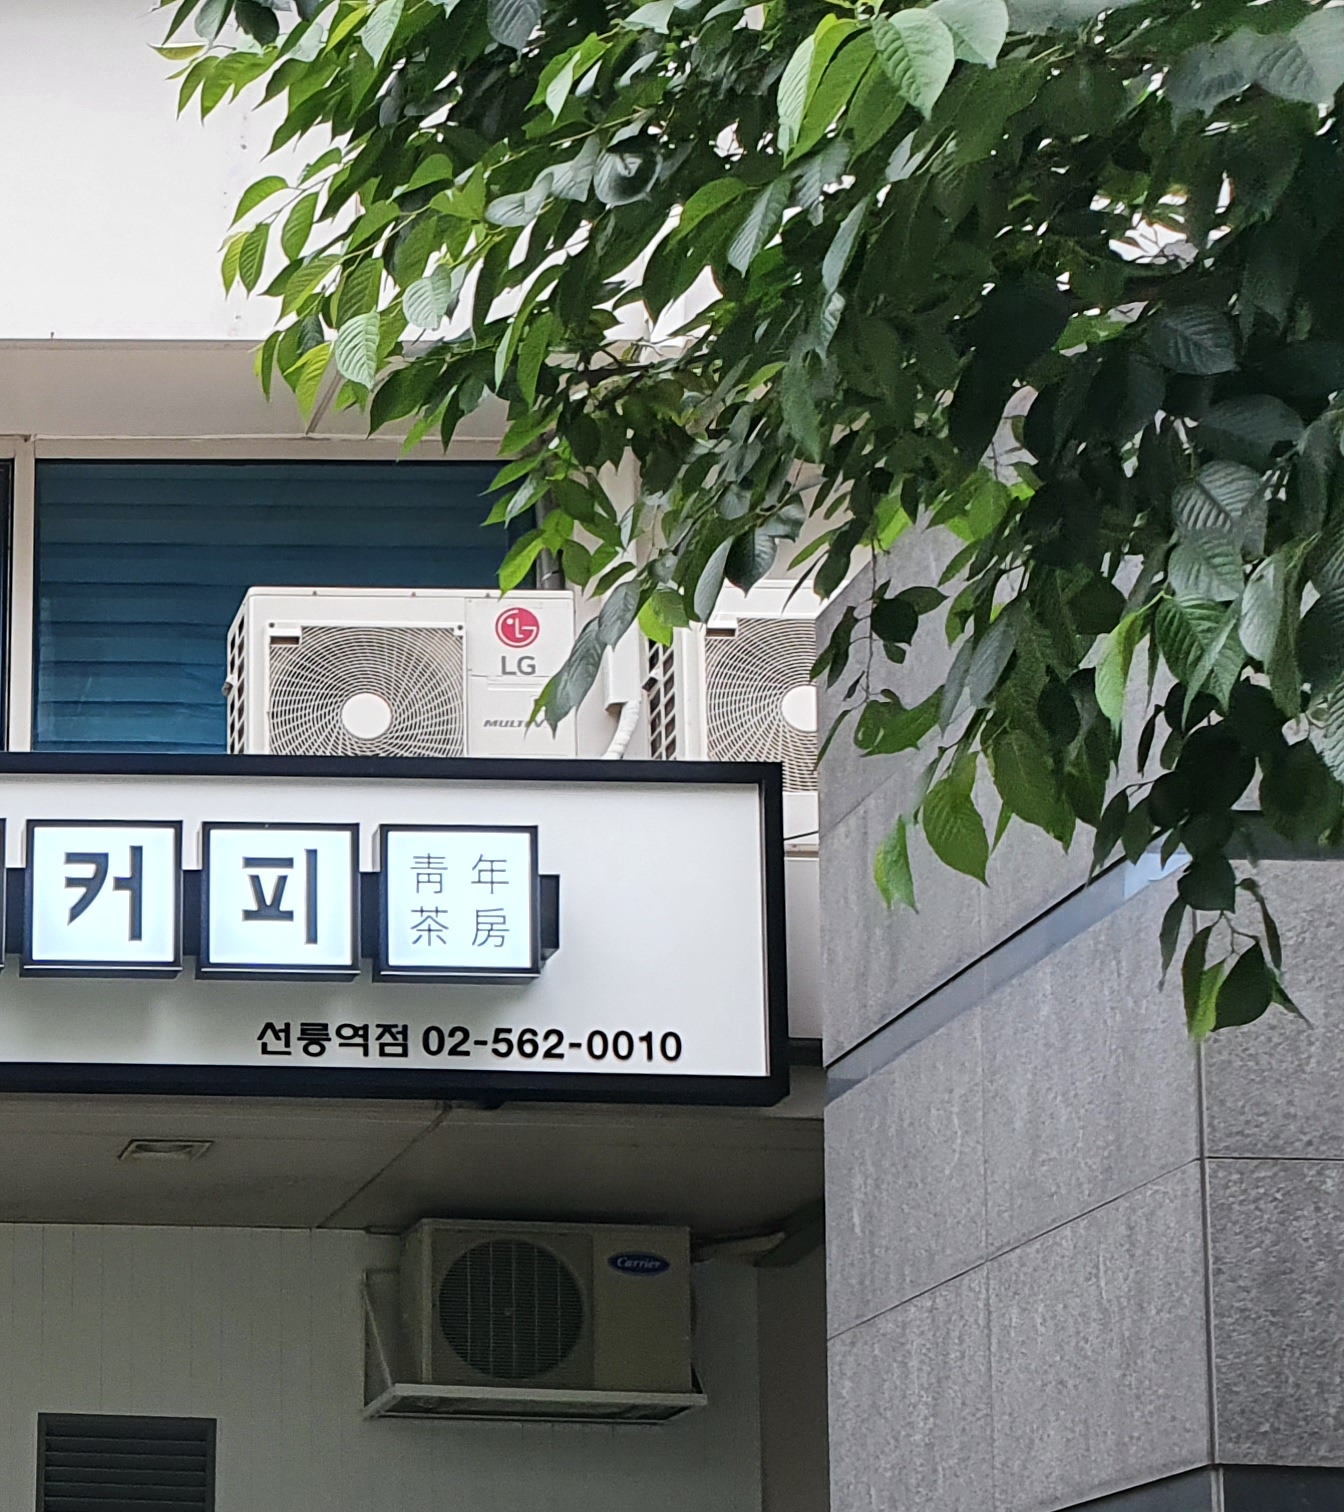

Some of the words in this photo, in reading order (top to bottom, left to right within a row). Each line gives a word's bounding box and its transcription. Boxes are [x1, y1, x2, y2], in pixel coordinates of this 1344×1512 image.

[500, 655, 537, 676] LG
[482, 719, 530, 728] MULT
[257, 1021, 410, 1058] 선릉역점
[422, 1025, 683, 1063] 02-562-0010
[617, 1256, 662, 1269] Carrier
